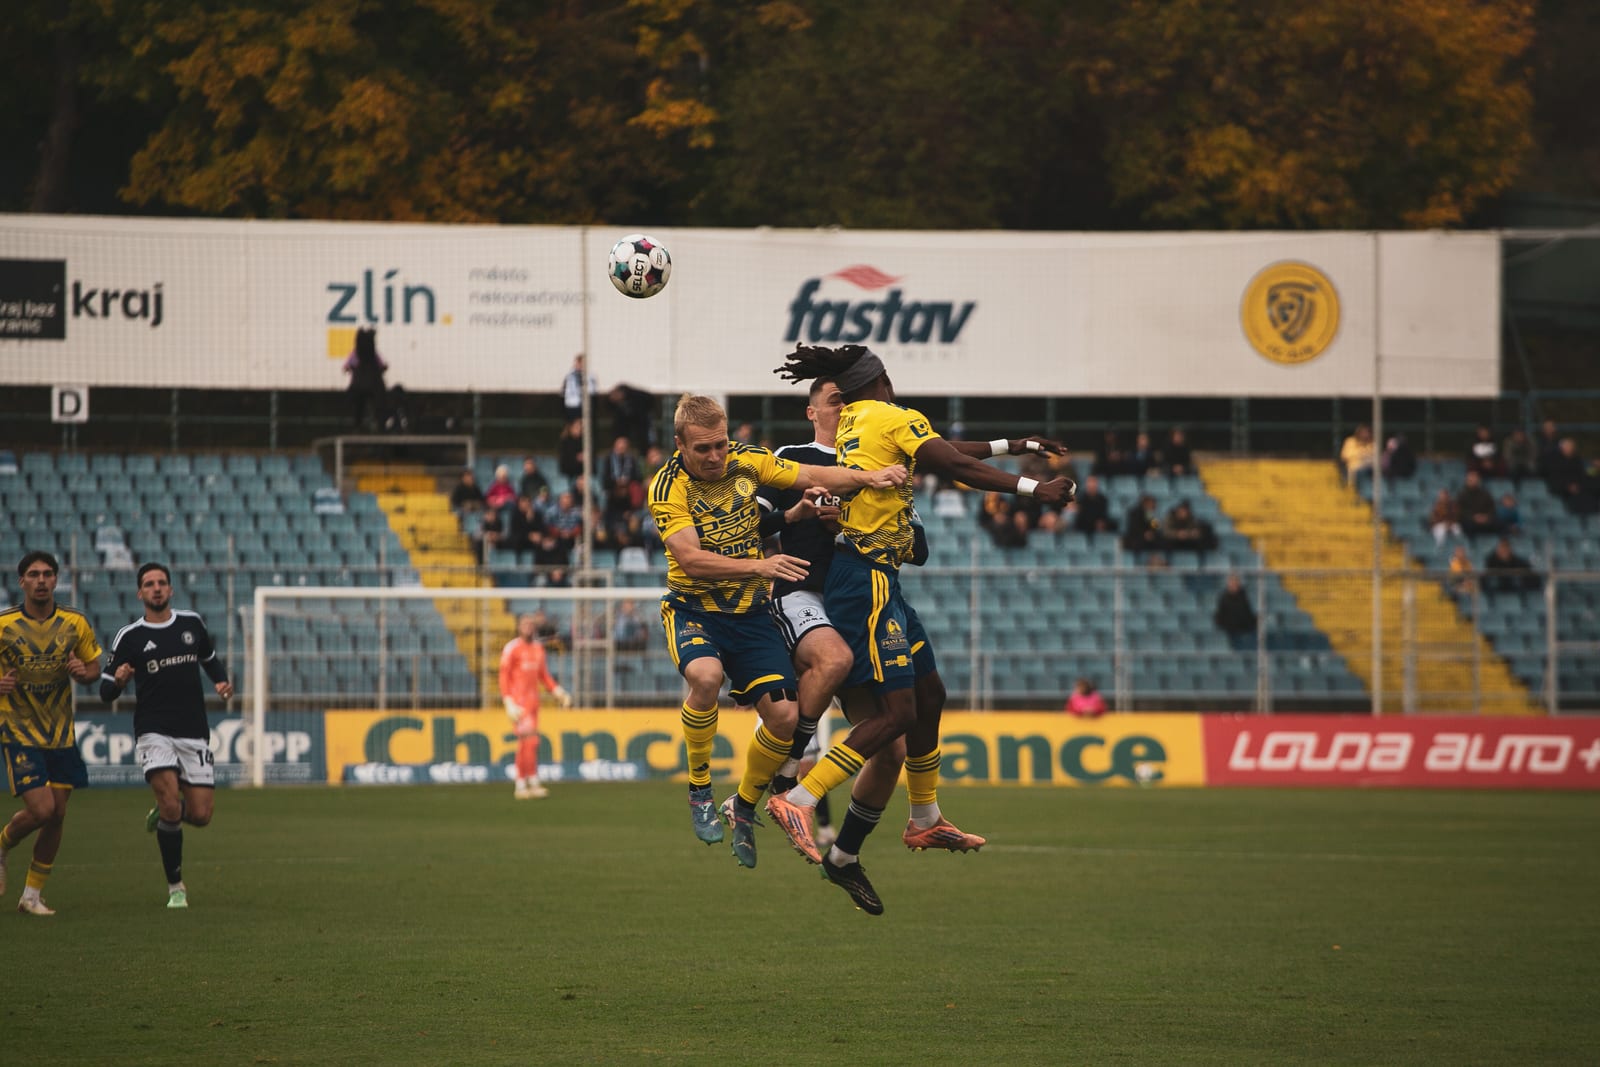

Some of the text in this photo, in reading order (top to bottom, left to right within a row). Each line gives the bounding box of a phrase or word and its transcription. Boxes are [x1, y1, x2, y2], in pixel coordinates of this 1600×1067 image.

[633, 259, 645, 291] SELECT
[72, 280, 164, 328] kraj
[784, 278, 976, 343] fastav
[58, 390, 82, 417] D
[829, 717, 1167, 781] ance
